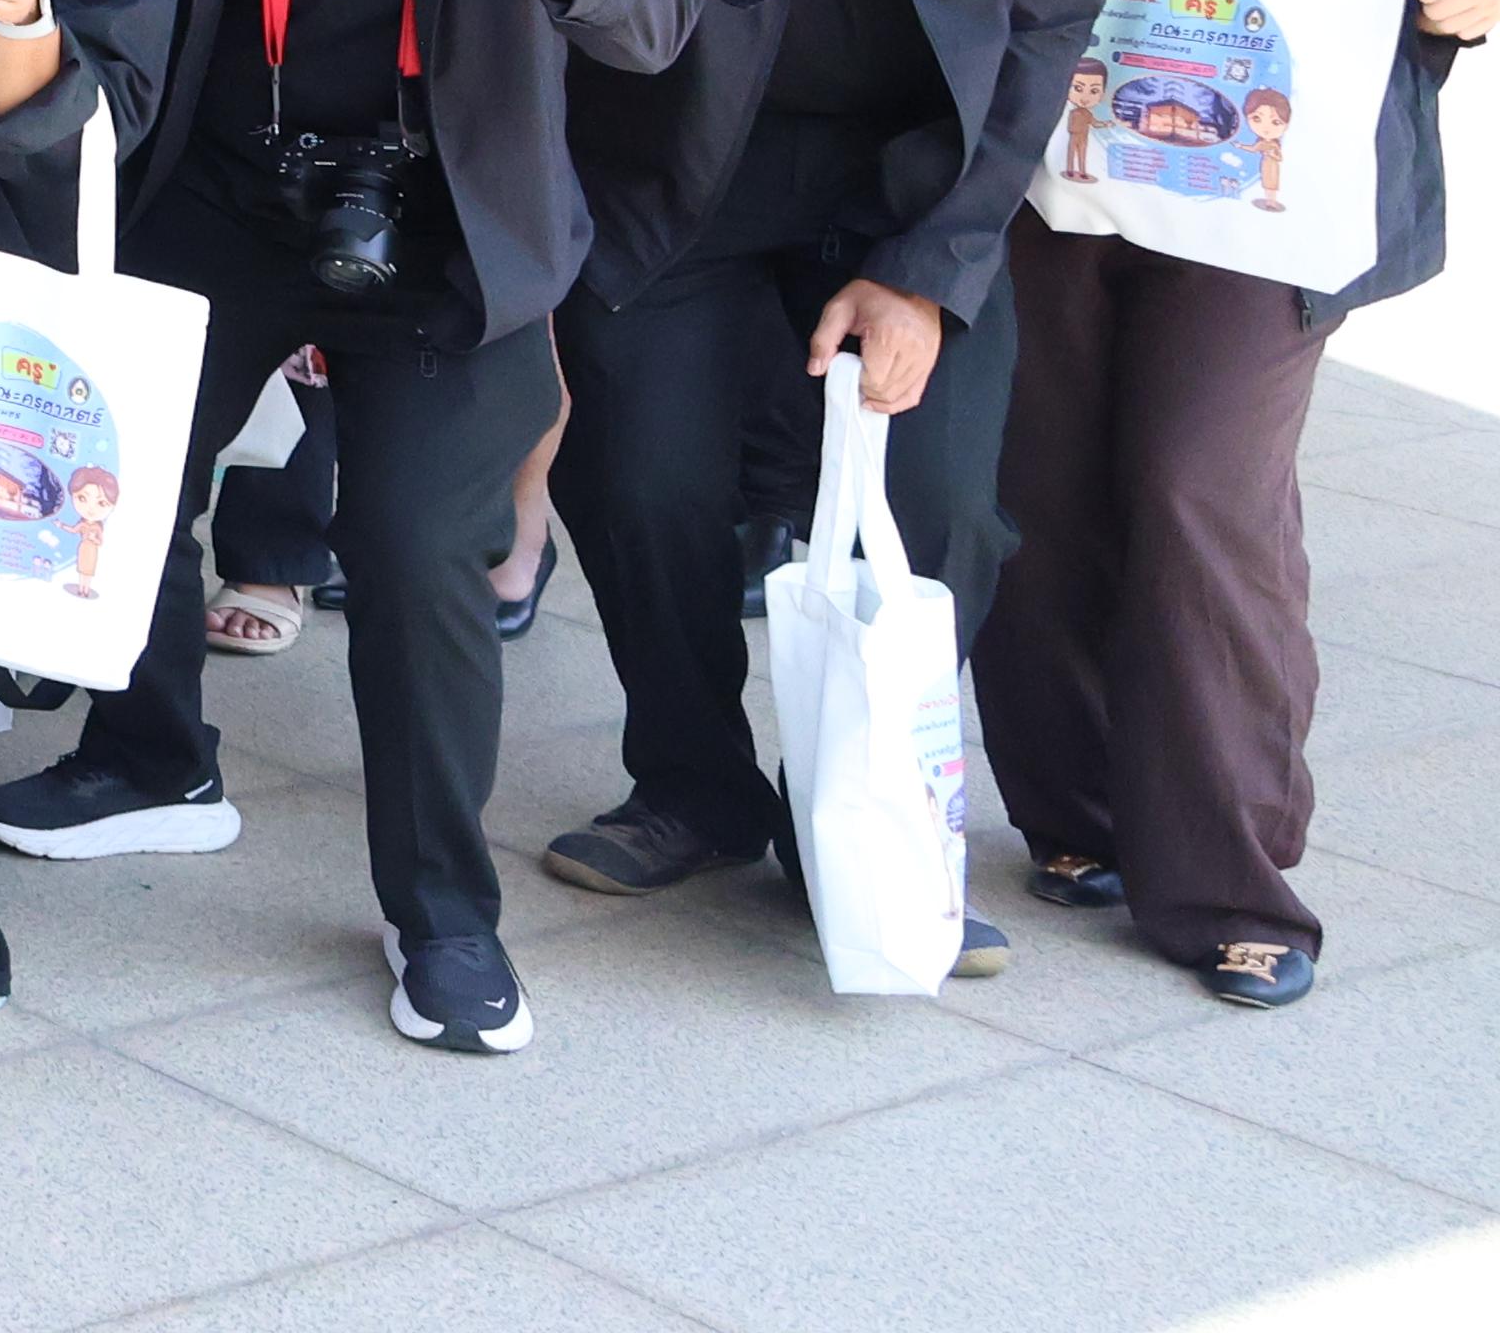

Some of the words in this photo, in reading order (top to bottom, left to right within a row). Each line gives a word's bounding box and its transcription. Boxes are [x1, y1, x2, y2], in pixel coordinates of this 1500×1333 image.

[1150, 22, 1279, 52] คณะครุศาสตร์
[16, 357, 44, 386] ครู
